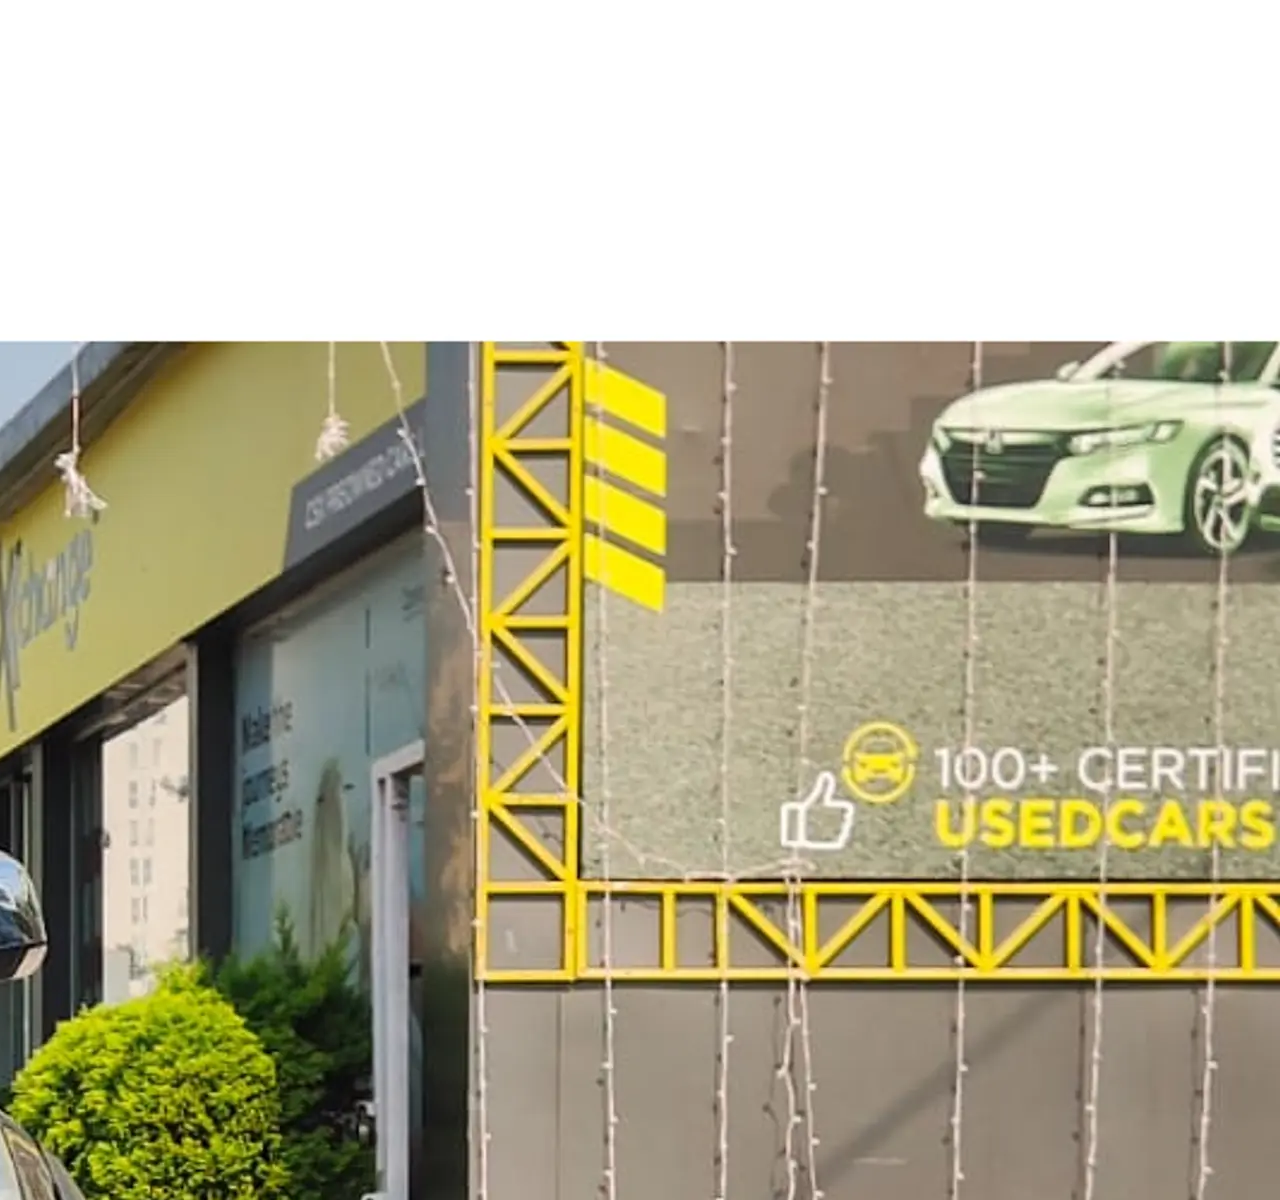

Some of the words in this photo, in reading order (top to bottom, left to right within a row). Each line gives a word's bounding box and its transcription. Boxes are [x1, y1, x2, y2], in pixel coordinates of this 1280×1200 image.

[934, 747, 1059, 790] 100+
[1077, 747, 1280, 791] CERTIFI
[934, 799, 1277, 849] USEDCARS
